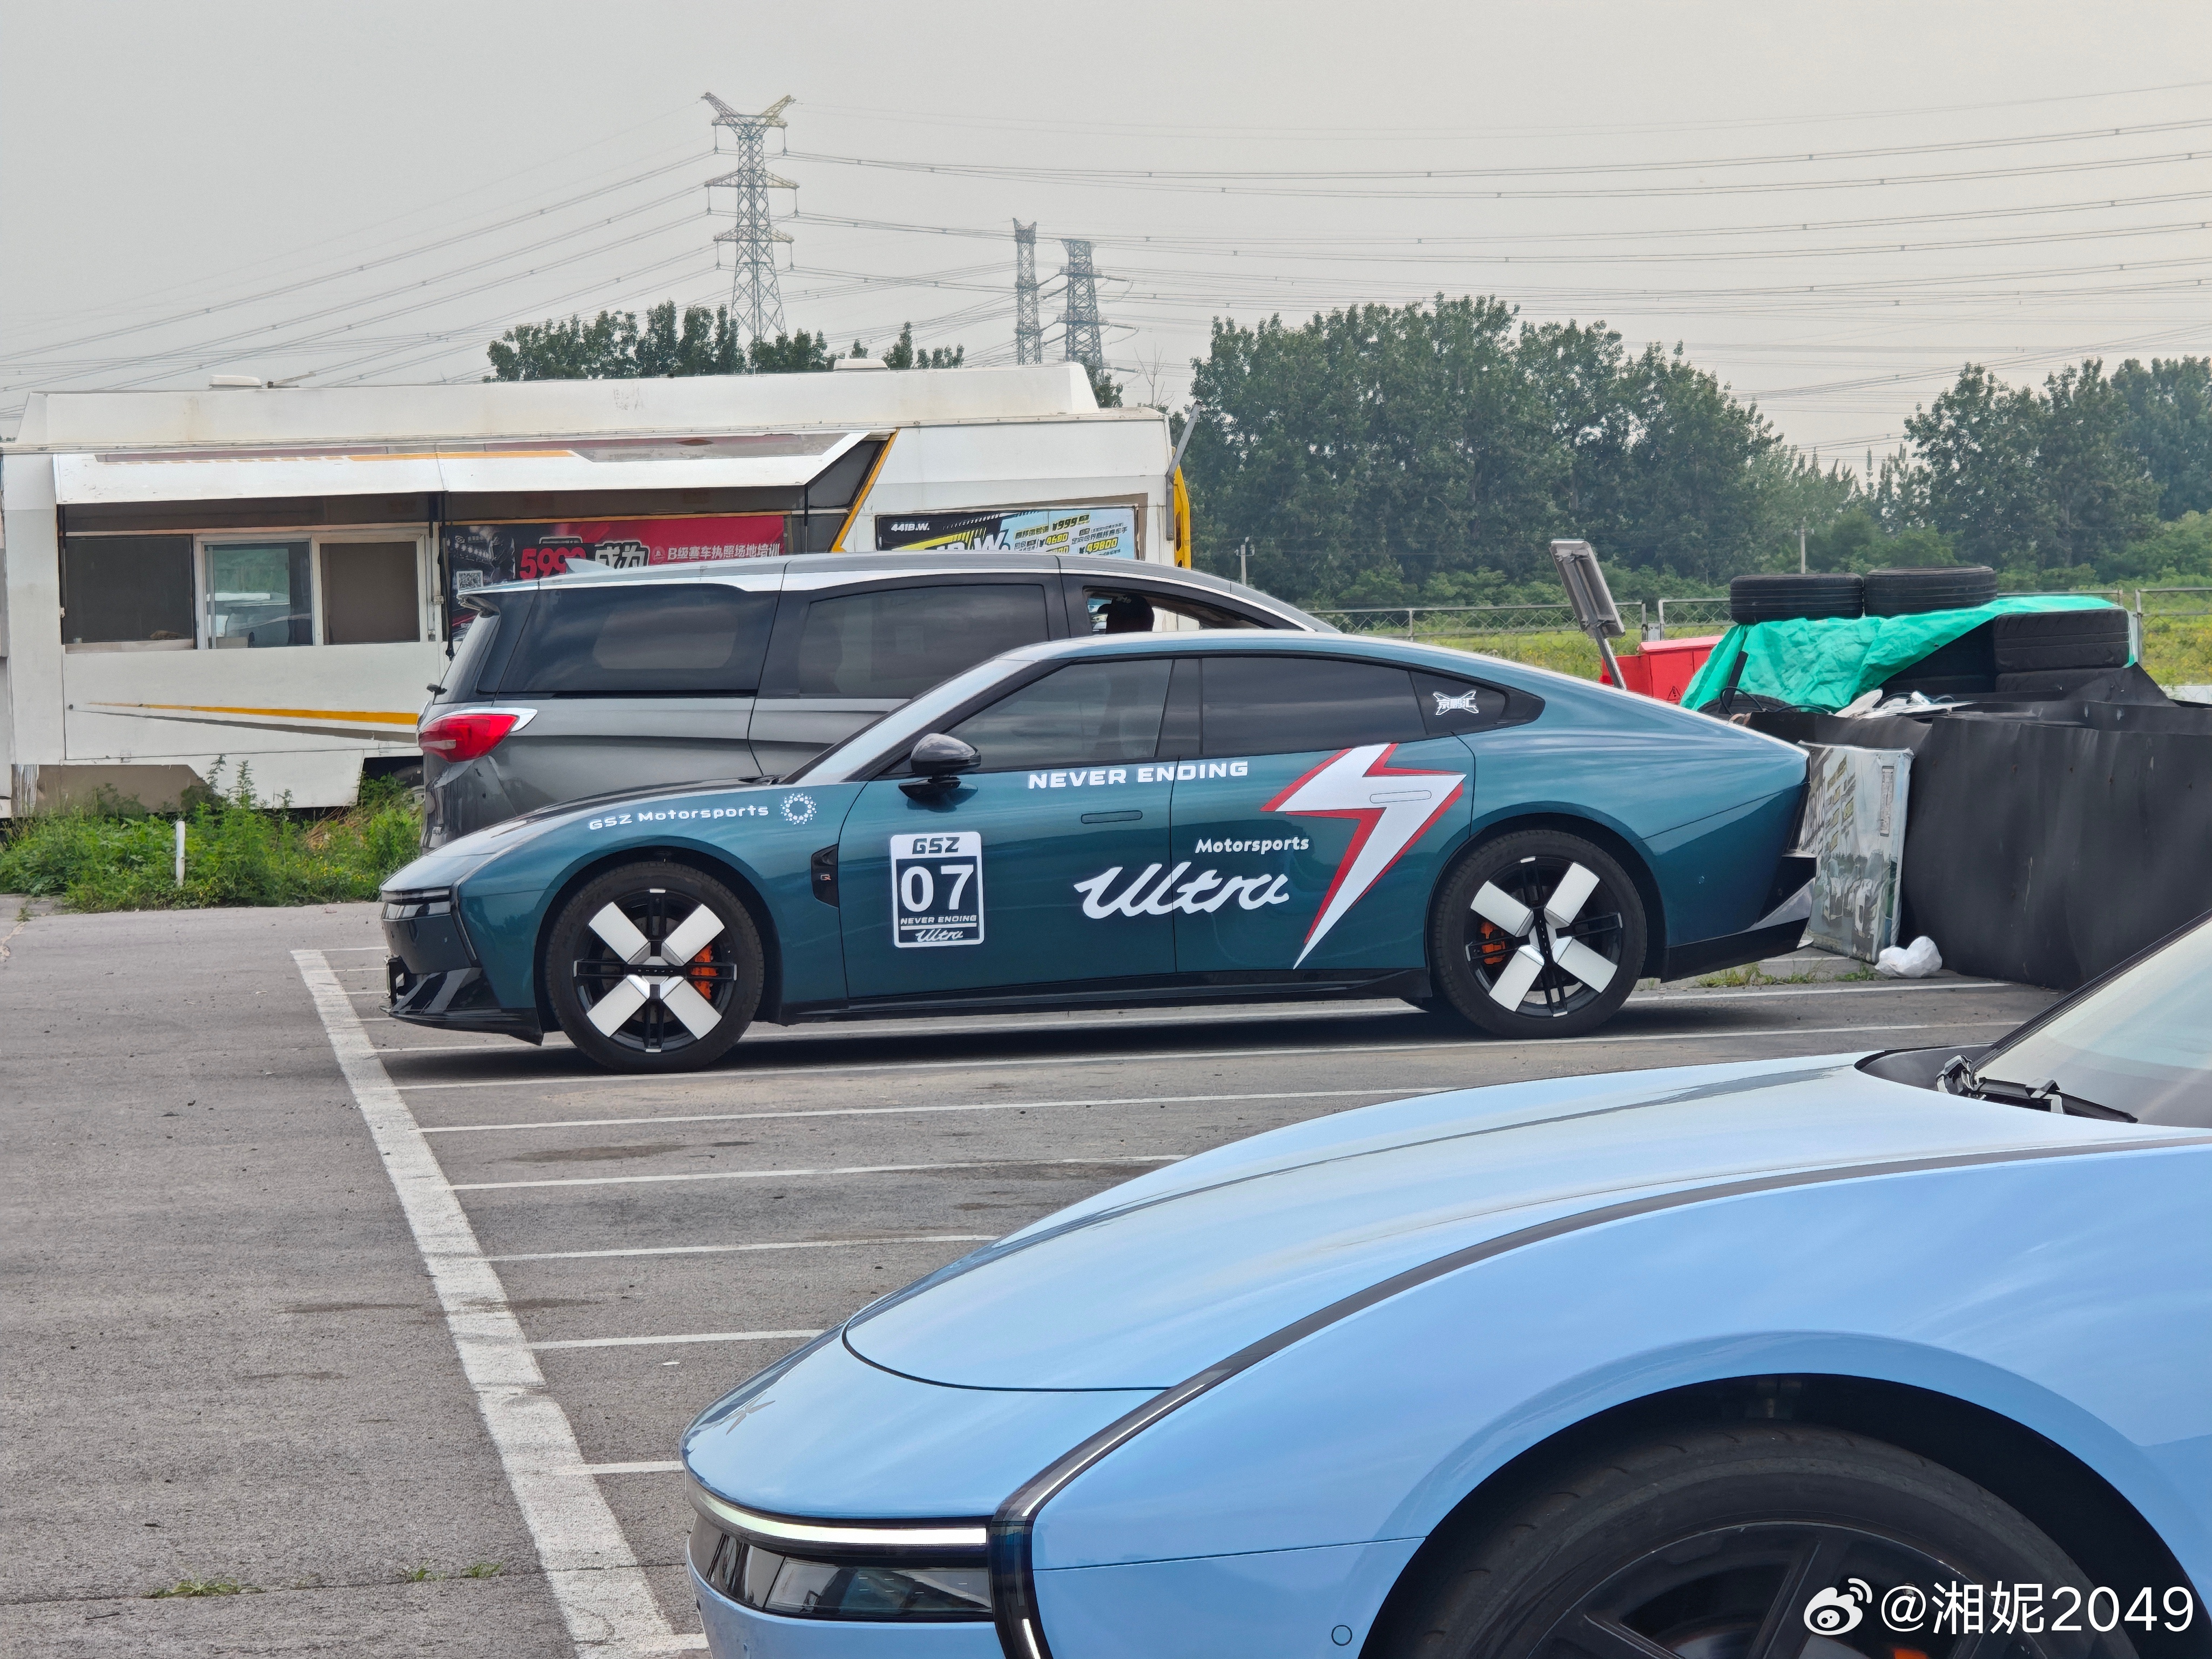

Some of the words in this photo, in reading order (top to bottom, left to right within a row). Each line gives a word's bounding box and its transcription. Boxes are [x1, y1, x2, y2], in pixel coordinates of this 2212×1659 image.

[1028, 768, 1127, 789] NEVER
[1137, 761, 1249, 783] ENDING
[589, 814, 633, 830] GSZ
[638, 805, 769, 822] Motorsports
[912, 837, 960, 855] GSZ
[1195, 836, 1310, 855] Motorsports
[901, 864, 974, 912] 07
[1074, 861, 1290, 919] Ultra
[900, 916, 935, 926] NEVER
[938, 914, 977, 923] ENDING
[915, 928, 964, 942] Ultra
